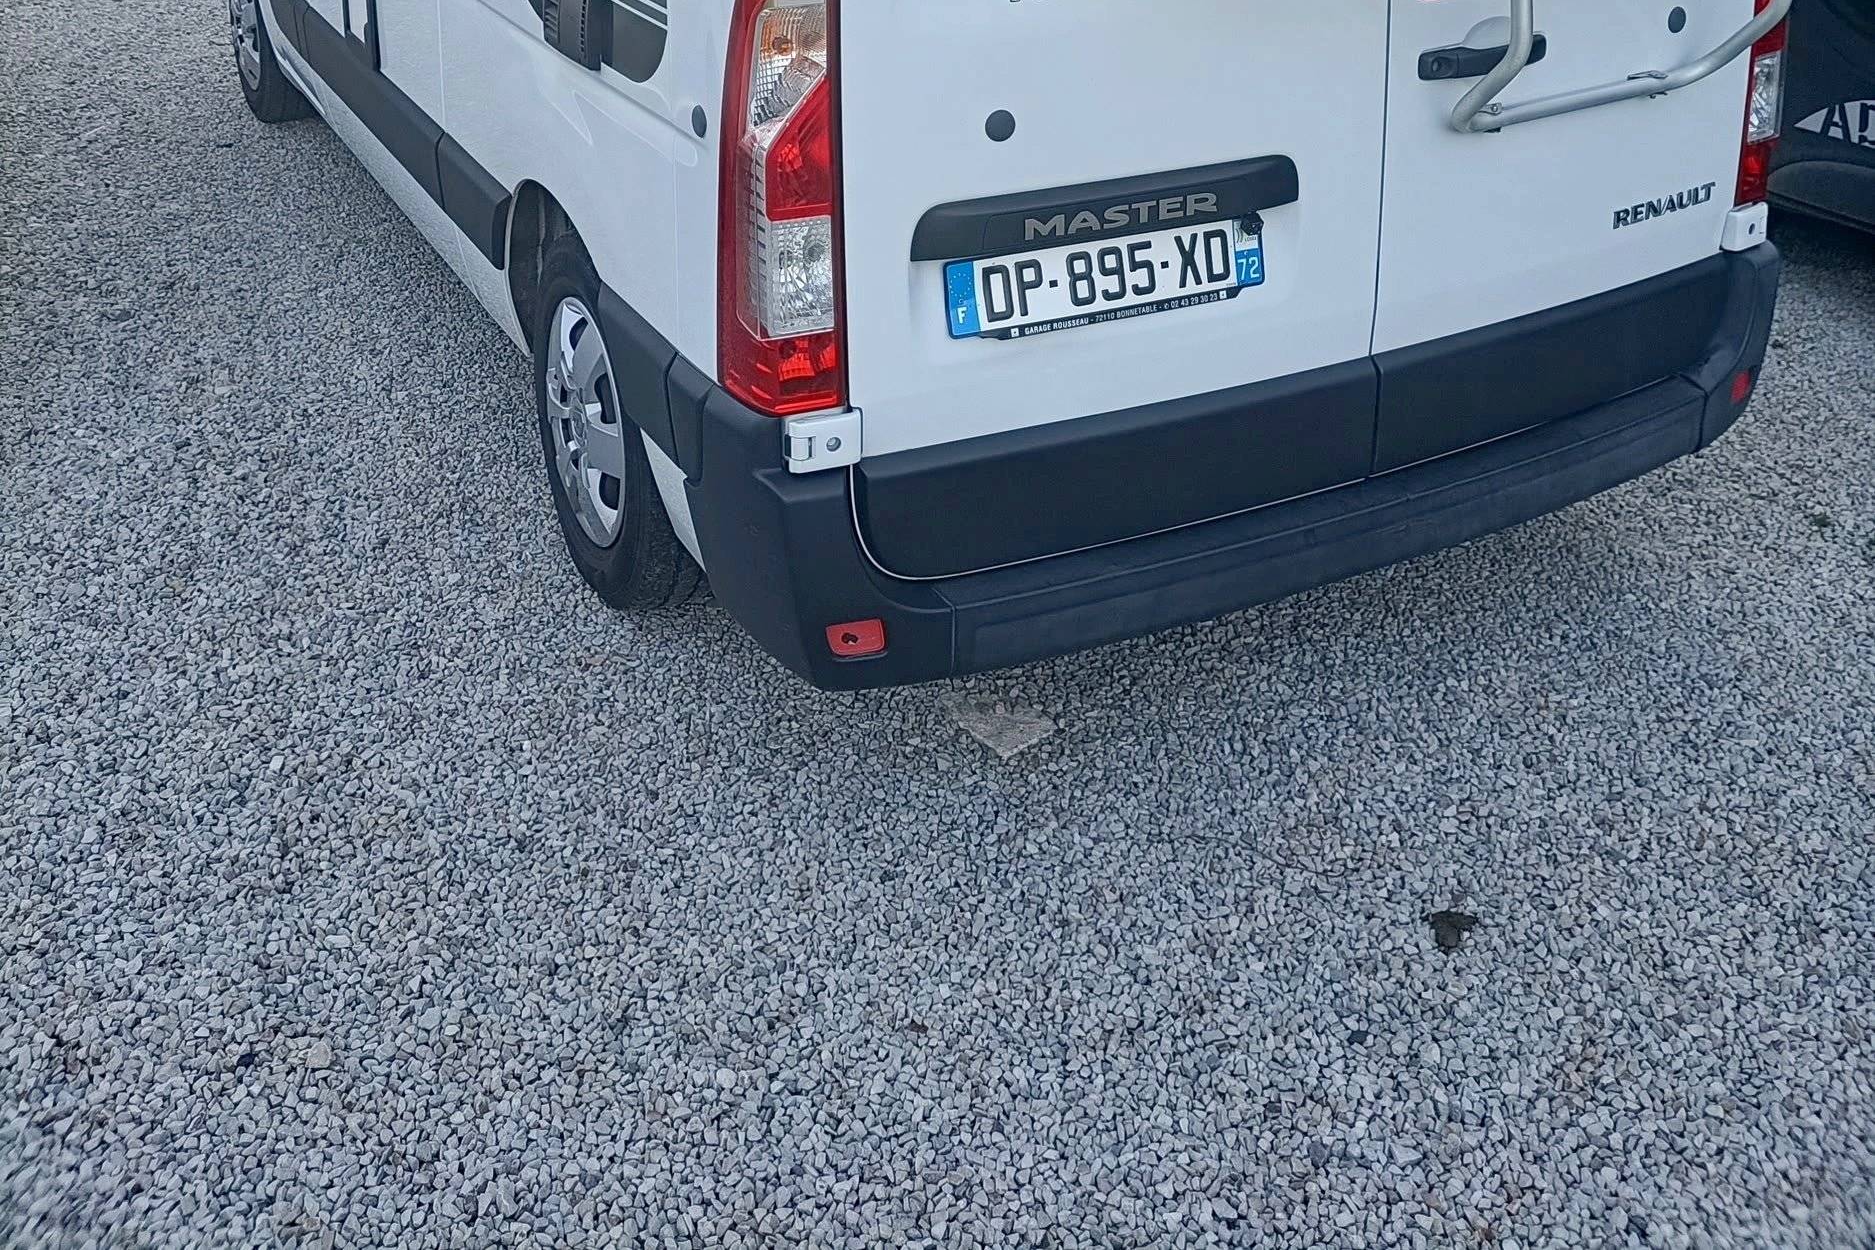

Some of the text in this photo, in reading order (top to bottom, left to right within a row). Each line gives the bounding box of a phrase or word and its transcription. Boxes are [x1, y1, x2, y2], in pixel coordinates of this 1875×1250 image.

[1023, 192, 1218, 242] MASTER
[1612, 181, 1717, 230] RENAULT
[1237, 256, 1260, 281] 72
[957, 306, 968, 324] F
[1024, 323, 1052, 335] GARAGE
[1052, 317, 1090, 330] ROUSSEAU
[1095, 311, 1115, 323] 72110
[1116, 304, 1158, 319] BONNETABLE
[1170, 300, 1179, 309] 02
[1180, 298, 1189, 306] 43
[1190, 296, 1199, 304] 29
[1200, 294, 1208, 303] 30
[1209, 293, 1218, 301] 23
